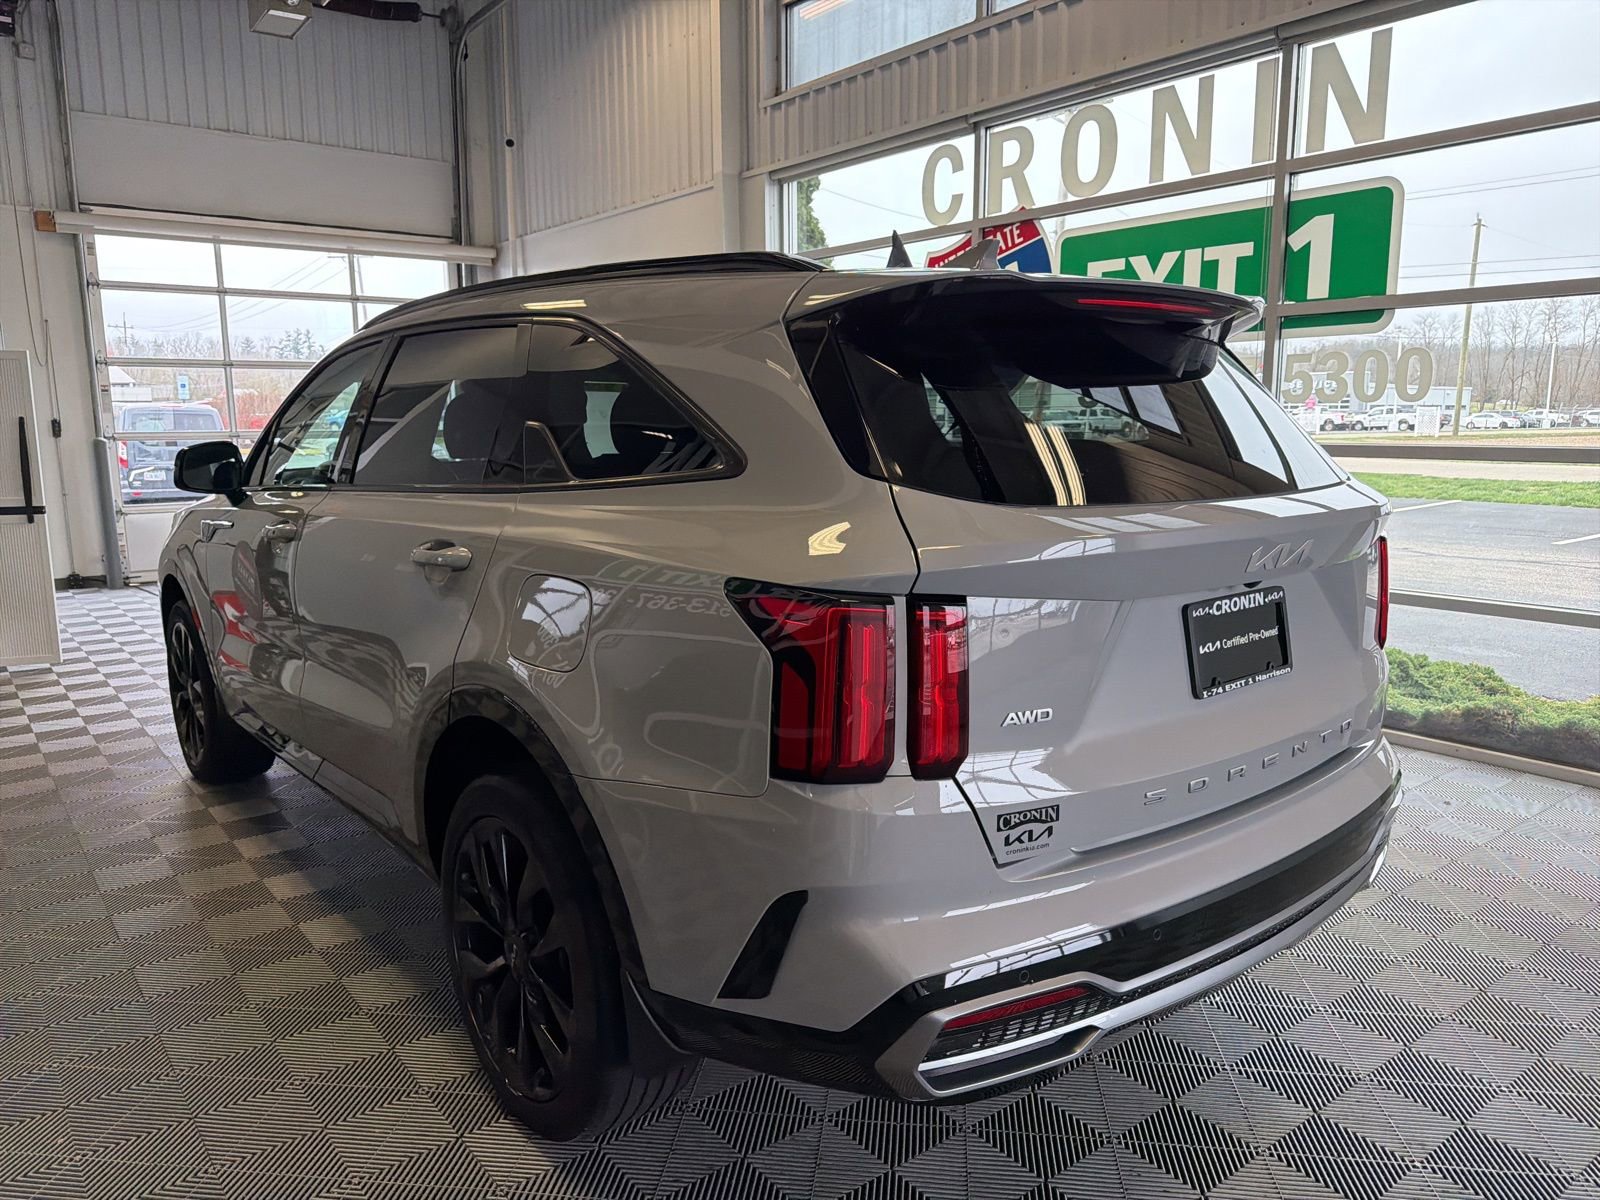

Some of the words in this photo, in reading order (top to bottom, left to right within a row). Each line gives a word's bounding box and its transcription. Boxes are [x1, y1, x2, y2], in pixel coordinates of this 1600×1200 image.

[921, 27, 1394, 226] CRONIN
[1287, 213, 1335, 300] 1
[1281, 346, 1434, 404] 5300
[1245, 538, 1315, 573] KIA
[1212, 591, 1265, 616] CRONIN
[1199, 640, 1221, 655] KIA
[1222, 634, 1249, 649] Certified
[1249, 626, 1279, 641] Pre-Owned
[1202, 686, 1224, 699] I-74
[1225, 679, 1247, 692] EXIT
[1248, 677, 1254, 685] 1
[1255, 666, 1292, 682] Harrison
[1001, 707, 1054, 727] AWD
[1144, 718, 1353, 806] SORENTO
[999, 805, 1059, 831] CRONIN
[1004, 825, 1054, 847] KIA
[1005, 842, 1050, 856] croninkia.com
